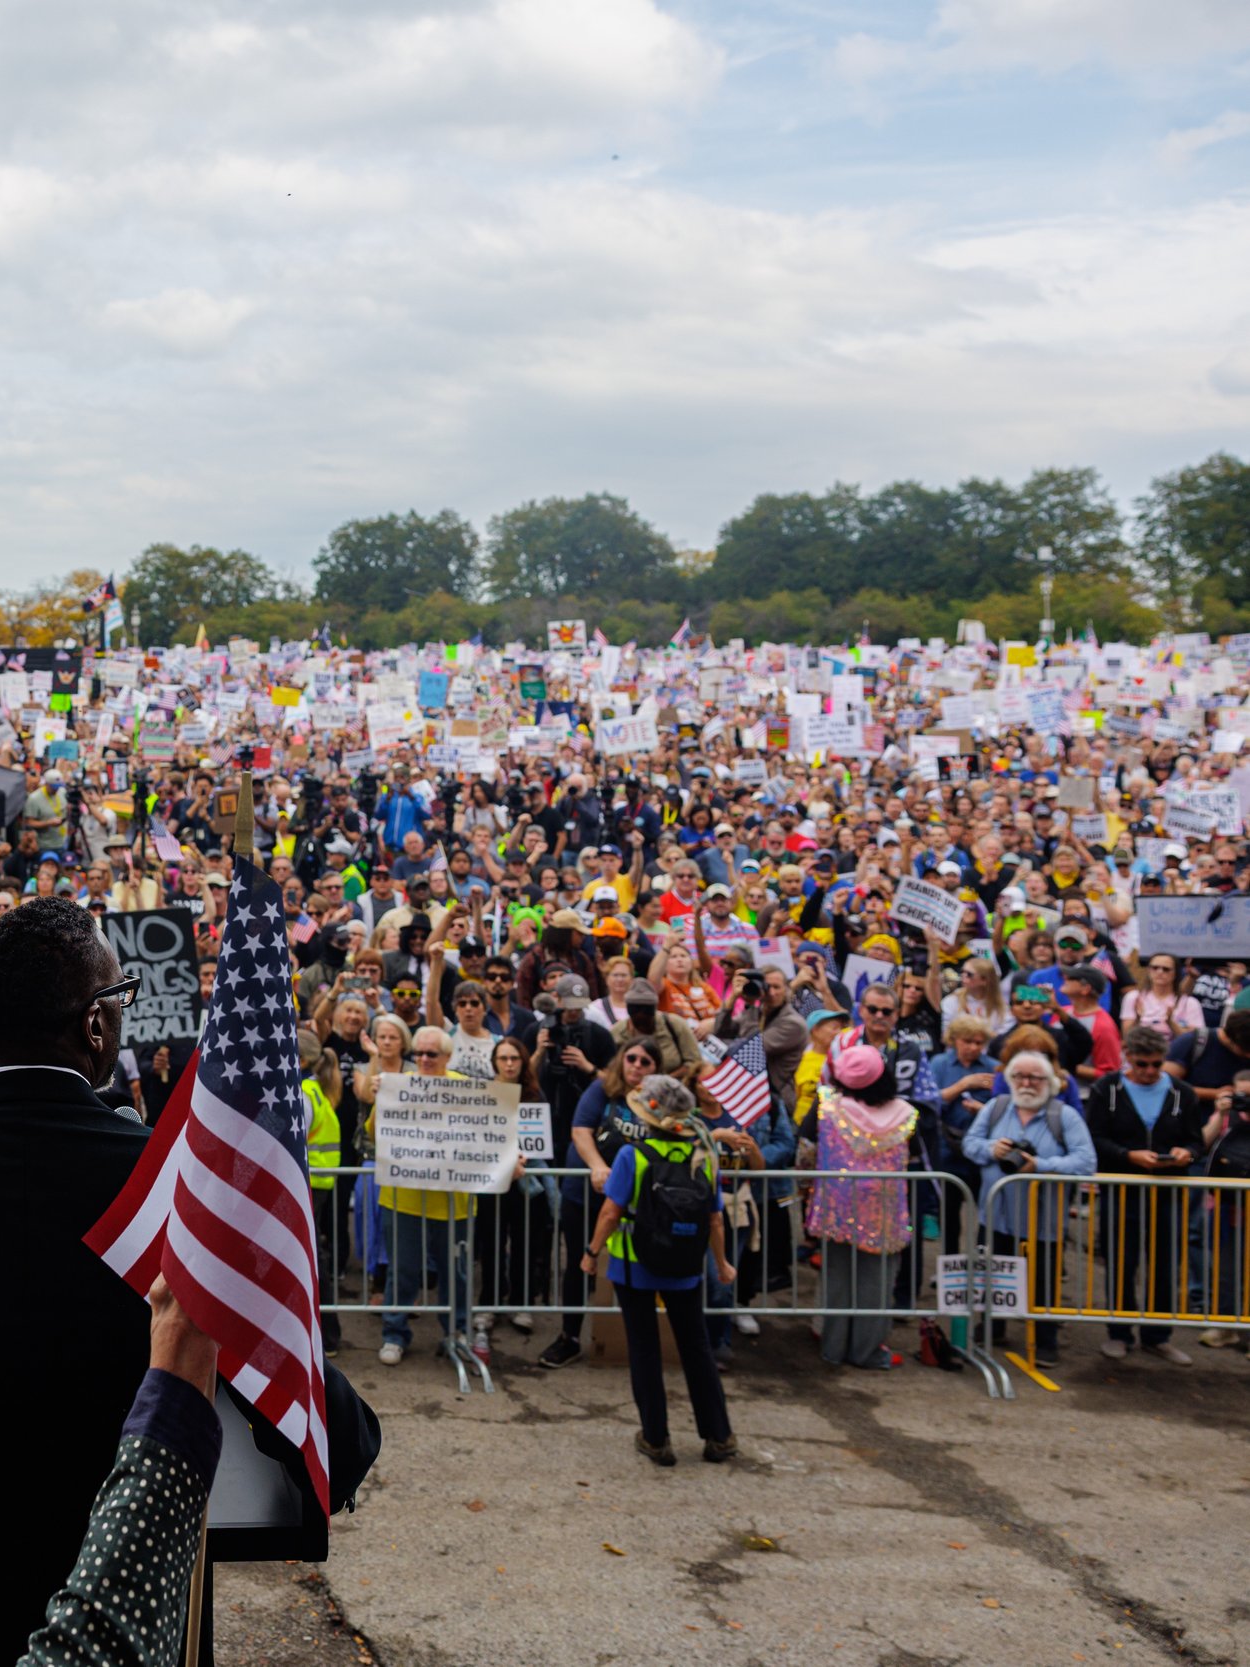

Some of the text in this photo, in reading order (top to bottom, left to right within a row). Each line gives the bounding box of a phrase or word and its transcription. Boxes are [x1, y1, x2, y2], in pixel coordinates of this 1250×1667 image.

[897, 903, 951, 937] CHICAGO
[106, 915, 184, 961] NO
[410, 1076, 487, 1091] My name is
[399, 1091, 438, 1104] David
[383, 1108, 507, 1127] and I am proud to
[519, 1107, 544, 1120] OFF
[380, 1125, 507, 1144] march against the
[390, 1144, 500, 1164] ignorant fascist
[389, 1165, 496, 1185] Donald Trump.
[945, 1289, 1017, 1308] CHIGO
